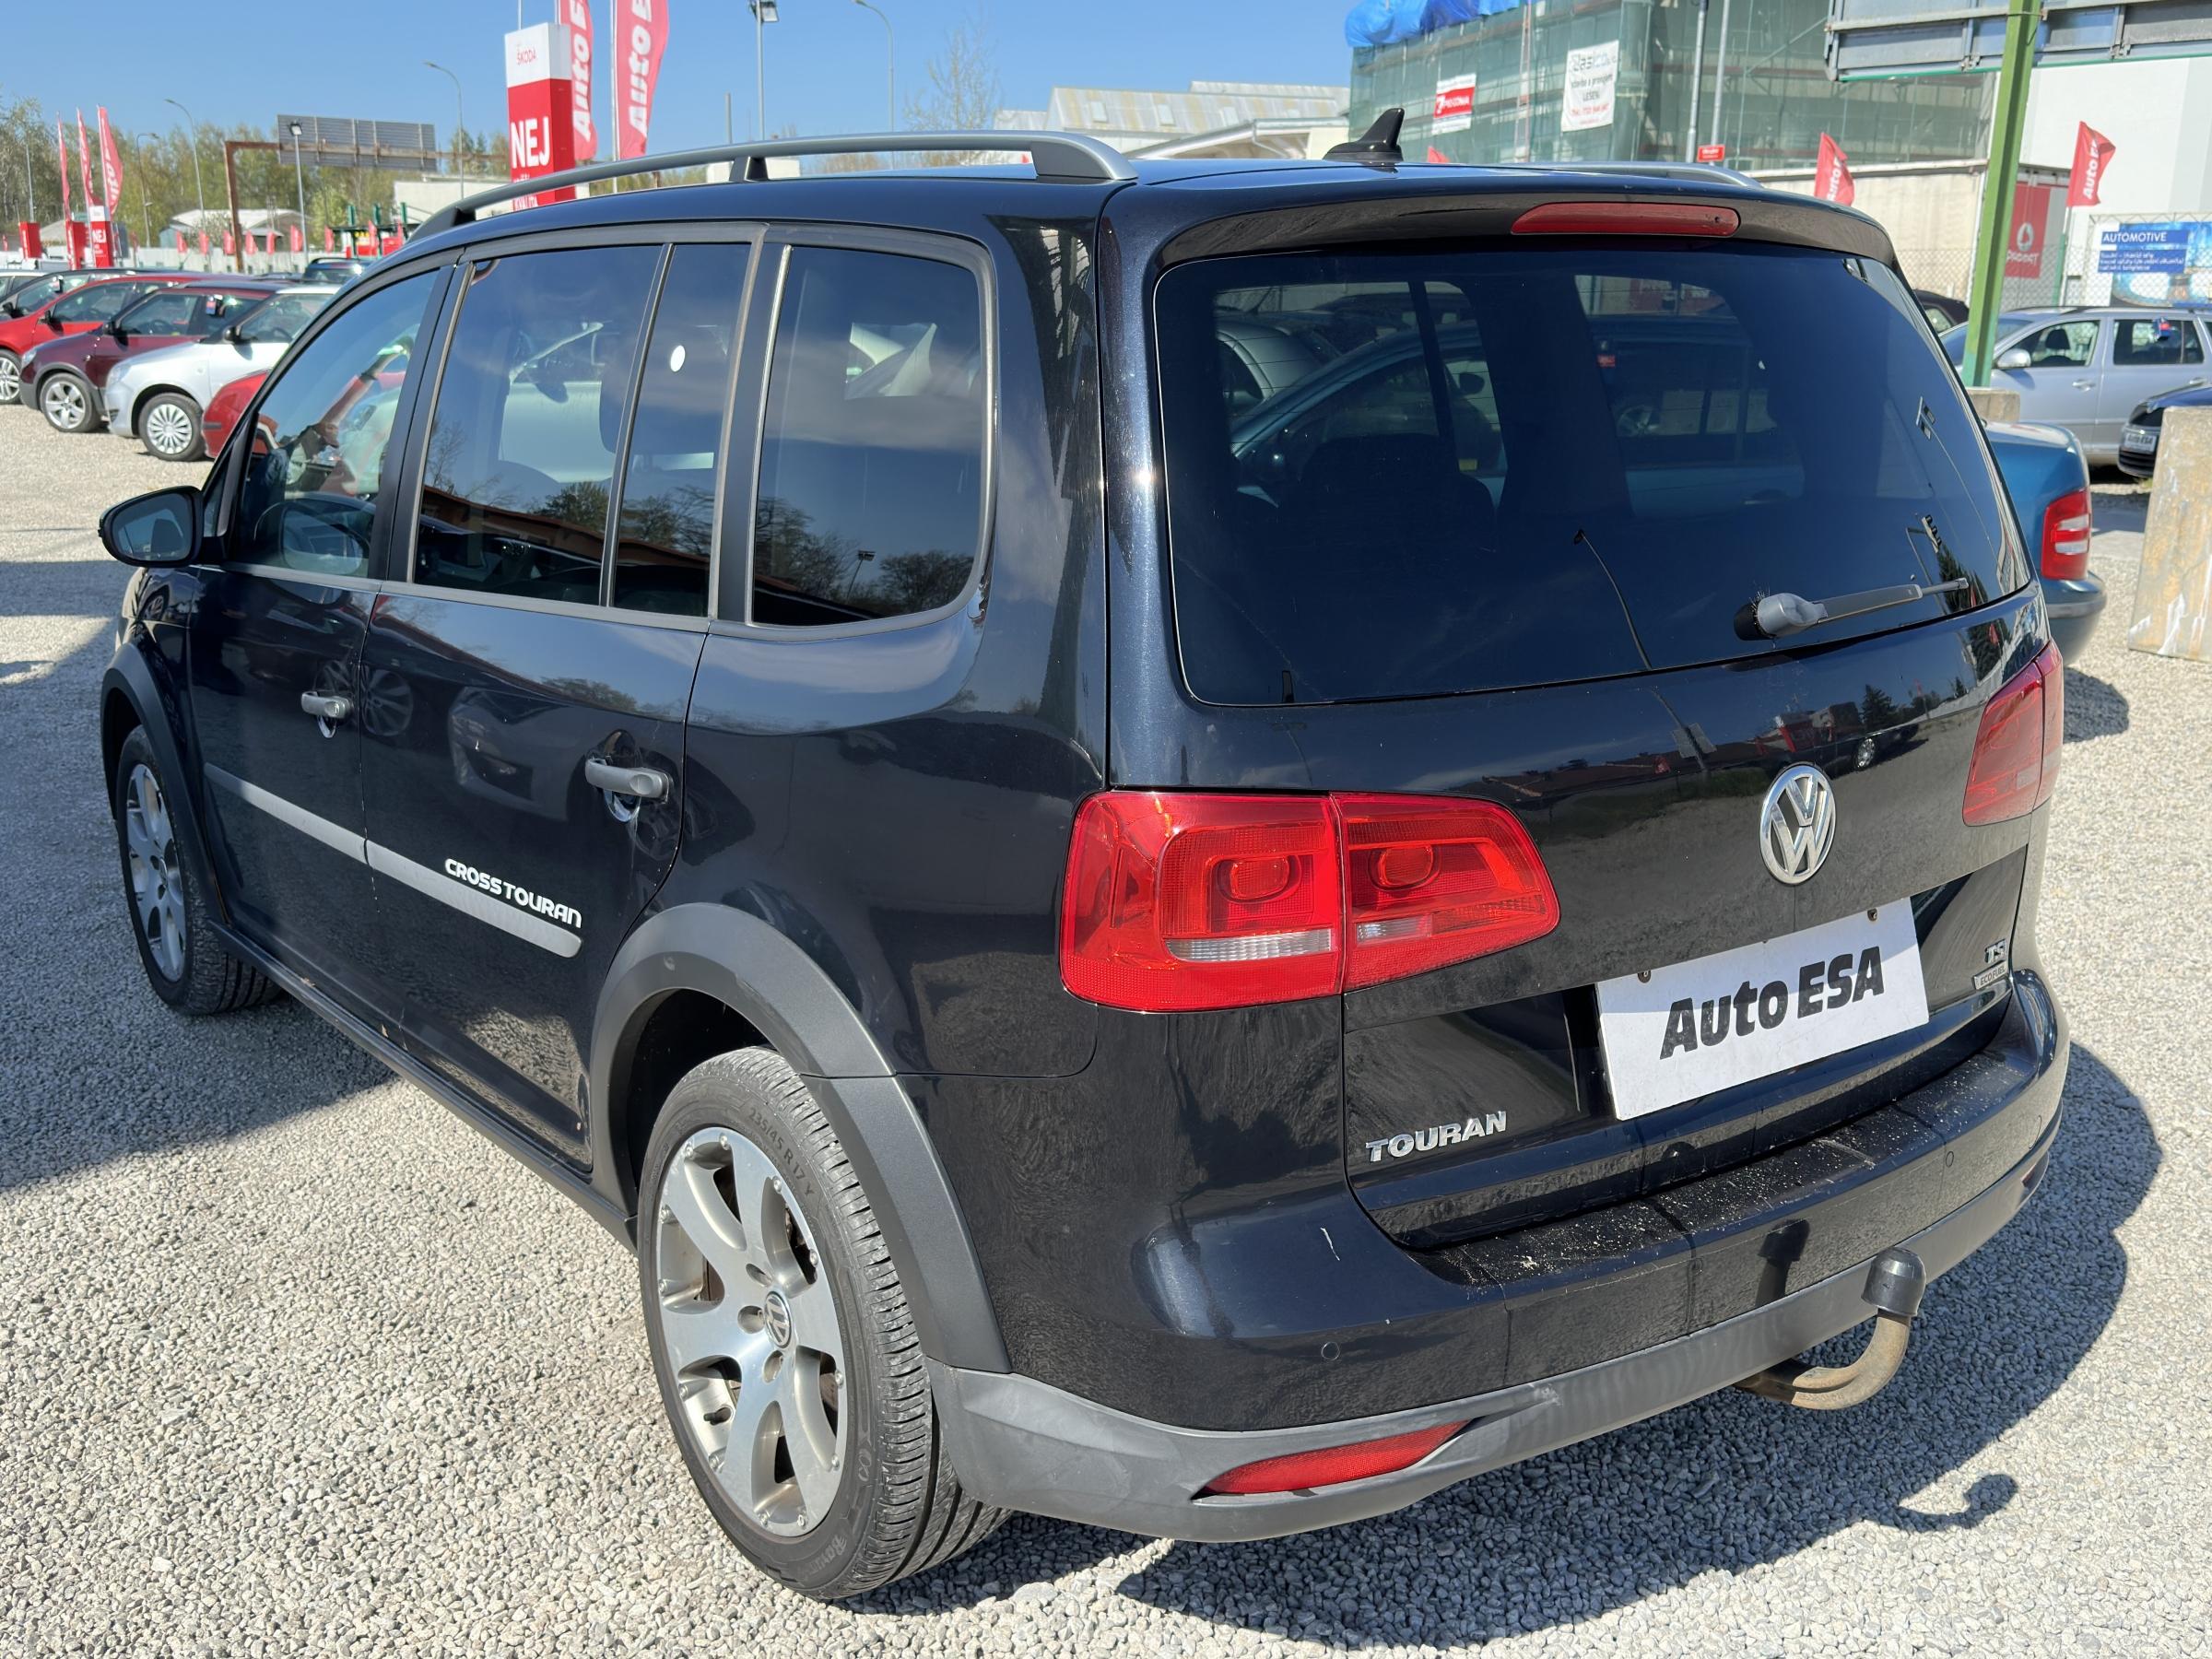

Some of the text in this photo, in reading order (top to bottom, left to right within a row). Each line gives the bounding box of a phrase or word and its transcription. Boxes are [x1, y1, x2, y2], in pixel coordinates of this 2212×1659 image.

[572, 33, 591, 142] Auto
[629, 25, 651, 138] Auto
[511, 116, 550, 169] NEJ
[2083, 159, 2099, 200] Auto
[2103, 231, 2168, 242] AUTOMOTIVE
[1659, 946, 1885, 1061] Auto ESA
[749, 1107, 783, 1150] 235/45
[783, 1147, 794, 1165] R
[1365, 1111, 1507, 1162] TOURAN
